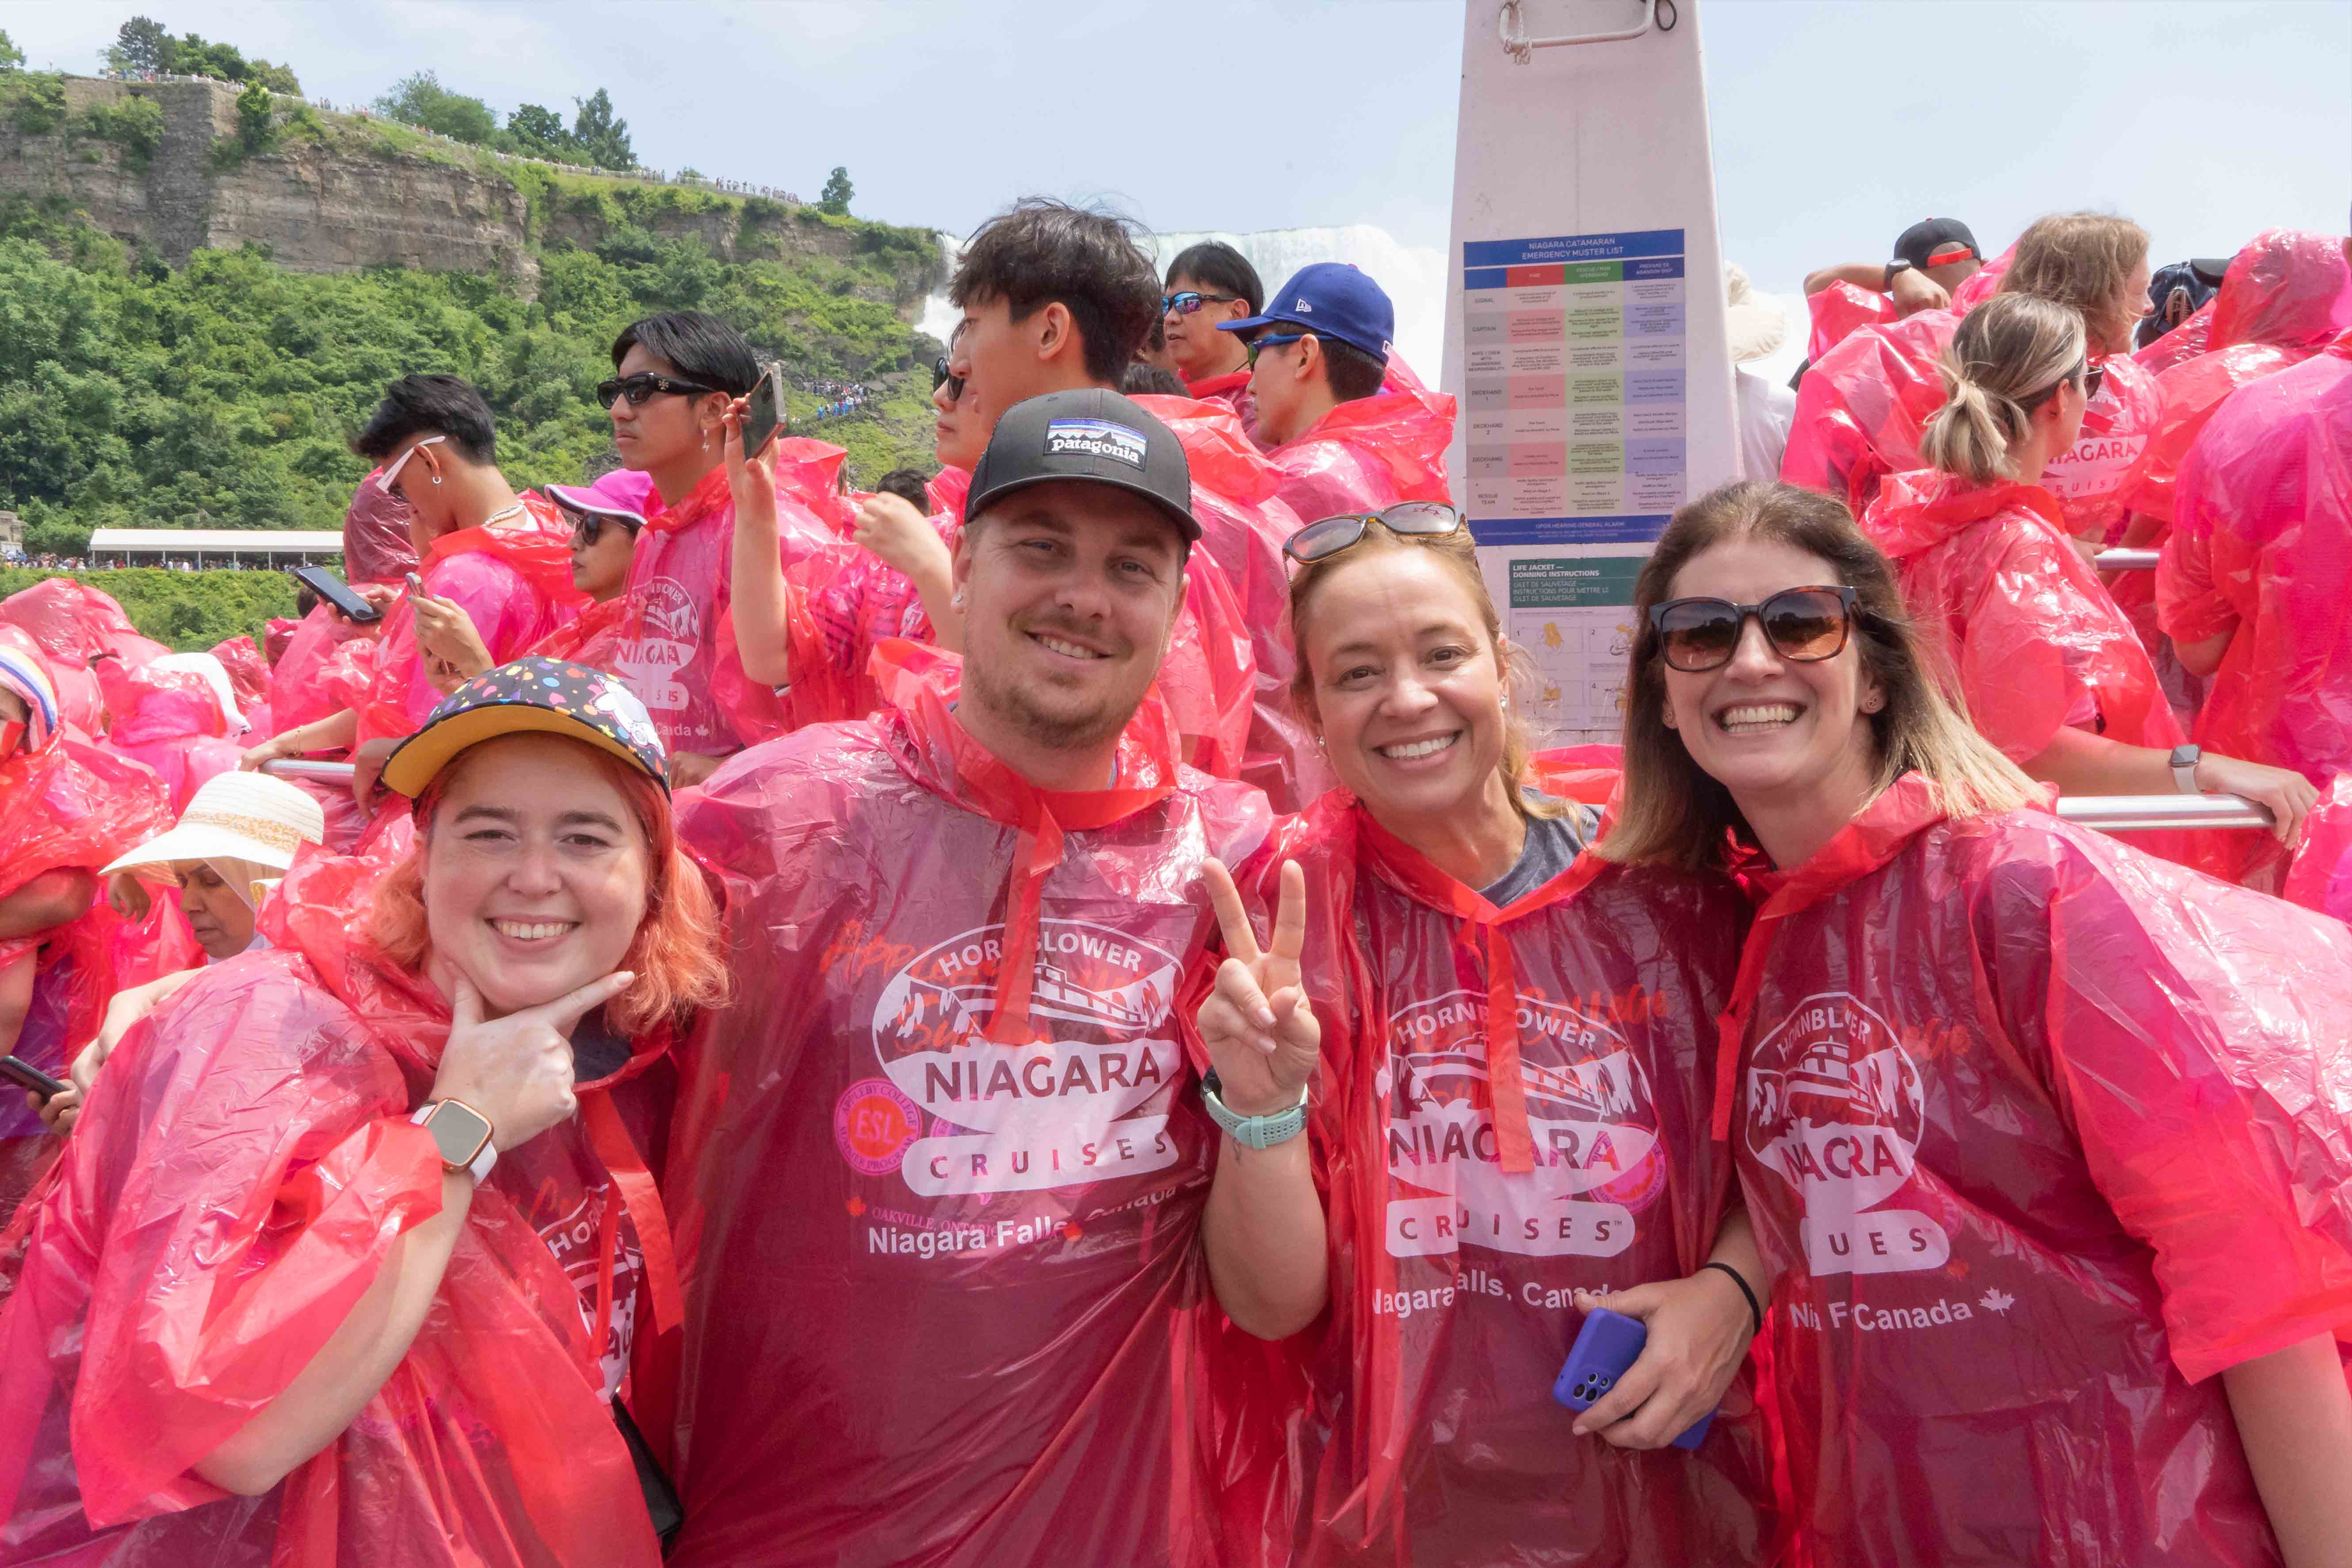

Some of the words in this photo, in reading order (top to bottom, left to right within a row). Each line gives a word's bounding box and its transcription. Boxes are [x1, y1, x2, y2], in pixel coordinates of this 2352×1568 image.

[1522, 250, 1570, 259] EMERGENCY
[1572, 248, 1605, 256] MUSTER
[1528, 241, 1565, 249] NIAGARA
[1565, 238, 1615, 248] CATAMARAN
[1051, 439, 1139, 463] patagonia
[2049, 442, 2139, 464] AGARA
[938, 931, 1142, 977] HORLOWER
[926, 1046, 1161, 1103] NIAGARA
[842, 1085, 878, 1115] APPLEBY
[881, 1086, 917, 1125] COLLEGE
[856, 1110, 895, 1145] ESL
[930, 1131, 1166, 1179] CRUISES
[1399, 1209, 1610, 1241] CRUISES
[868, 1226, 986, 1259] Niagara
[1457, 1269, 1511, 1301] alls,
[1853, 1298, 1974, 1331] Canada
